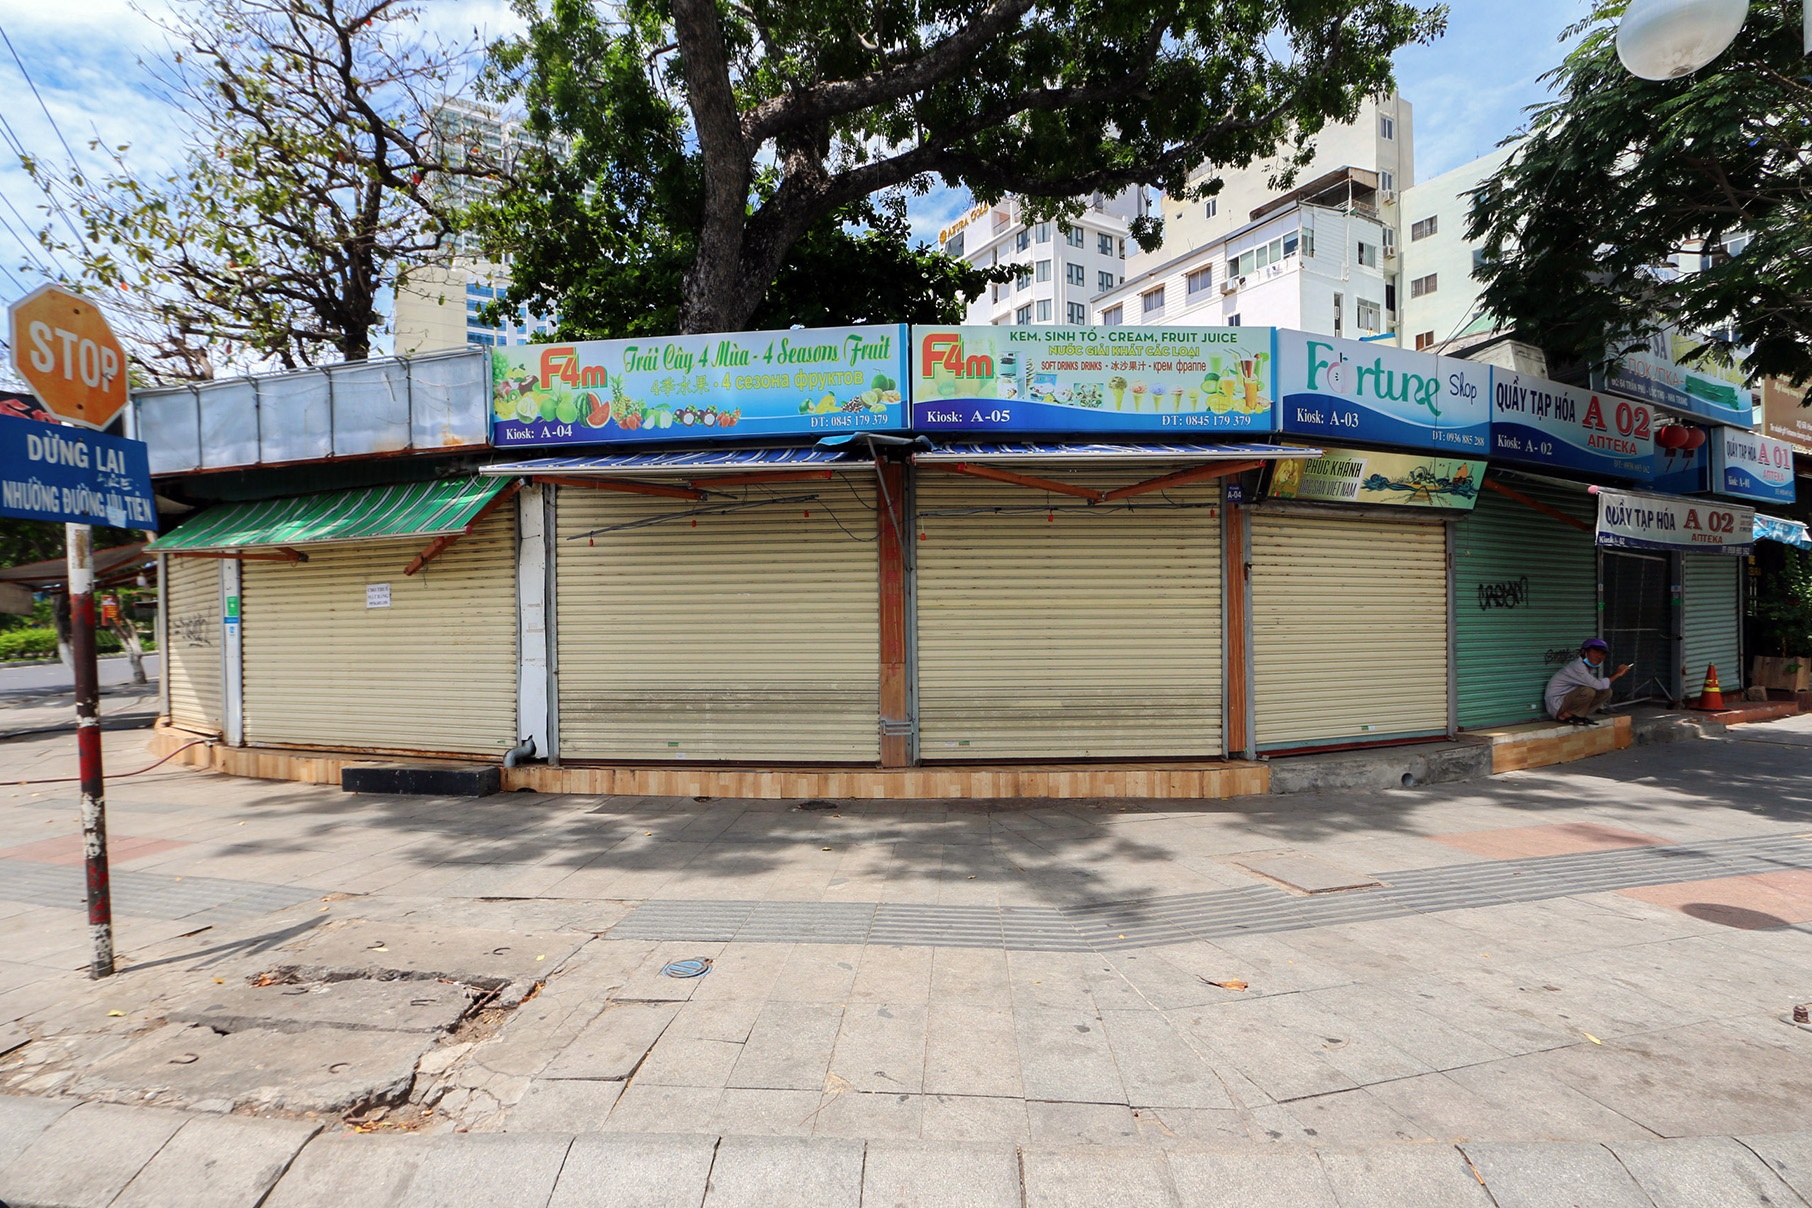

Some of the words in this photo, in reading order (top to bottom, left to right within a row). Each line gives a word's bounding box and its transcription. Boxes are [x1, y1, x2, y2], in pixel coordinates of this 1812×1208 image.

[1010, 331, 1041, 343] KEM,
[1045, 331, 1076, 342] SINH
[1079, 327, 1097, 342] TỐ
[1108, 331, 1158, 343] CREAM,
[1161, 332, 1198, 343] FRUIT
[1201, 332, 1238, 344] JUICE
[29, 320, 119, 393] STOP
[623, 345, 660, 374] Trái
[698, 340, 711, 369] 4
[711, 340, 750, 368] Mùa
[762, 337, 776, 365] 4
[777, 337, 840, 364] Seasons
[843, 334, 892, 367] Fruit
[921, 332, 996, 380] F4m
[1048, 344, 1084, 356] NƯỚC
[1112, 343, 1143, 357] KHÁT
[1145, 343, 1171, 357] CÁC
[1171, 345, 1200, 359] LOẠI
[539, 346, 609, 391] F4m
[1041, 361, 1056, 371] SOFT
[1057, 361, 1079, 371] DRINKS
[1081, 361, 1102, 371] DRINKS
[1110, 360, 1147, 372] 冰沙果汁
[1153, 362, 1173, 374] крем
[1176, 359, 1207, 374] фраппе
[721, 372, 732, 390] 4
[735, 372, 790, 390] сезона
[794, 368, 865, 391] фруктов
[1449, 371, 1477, 405] Shop
[926, 411, 963, 423] Kiosk:
[970, 409, 1011, 423] A-05
[1296, 407, 1325, 425] Kiosk:
[1329, 410, 1359, 428] A-03
[1496, 375, 1527, 413] QUẦY
[1530, 390, 1551, 421] TẠP
[1554, 391, 1576, 423] HÓA
[1582, 395, 1607, 432] A
[1615, 402, 1651, 441] 02
[810, 416, 829, 428] ĐT:
[831, 415, 852, 427] 0845
[854, 415, 870, 426] 179
[872, 414, 888, 425] 379
[1162, 415, 1183, 427] ĐT:
[1185, 415, 1210, 426] 0845
[1213, 415, 1231, 426] 179
[1233, 415, 1251, 426] 379
[505, 428, 535, 440] Kiosk:
[540, 424, 573, 438] A-04
[1497, 434, 1521, 450] Kiosk:
[27, 430, 89, 469] DỪNG
[1587, 433, 1638, 456] АПТЕКА
[1758, 442, 1770, 466] A
[1773, 445, 1791, 470] 01
[1331, 458, 1363, 478] KHÁNH
[2, 475, 59, 513] NHƯỜNG
[62, 482, 106, 518] ĐƯỜNG
[124, 490, 153, 523] TIÊN
[1340, 482, 1358, 498] NAM
[1635, 509, 1654, 532] TẠP
[1656, 507, 1676, 531] HÓA
[1683, 509, 1703, 530] A
[1708, 510, 1735, 534] 02
[1691, 533, 1723, 544] АПТЕКА
